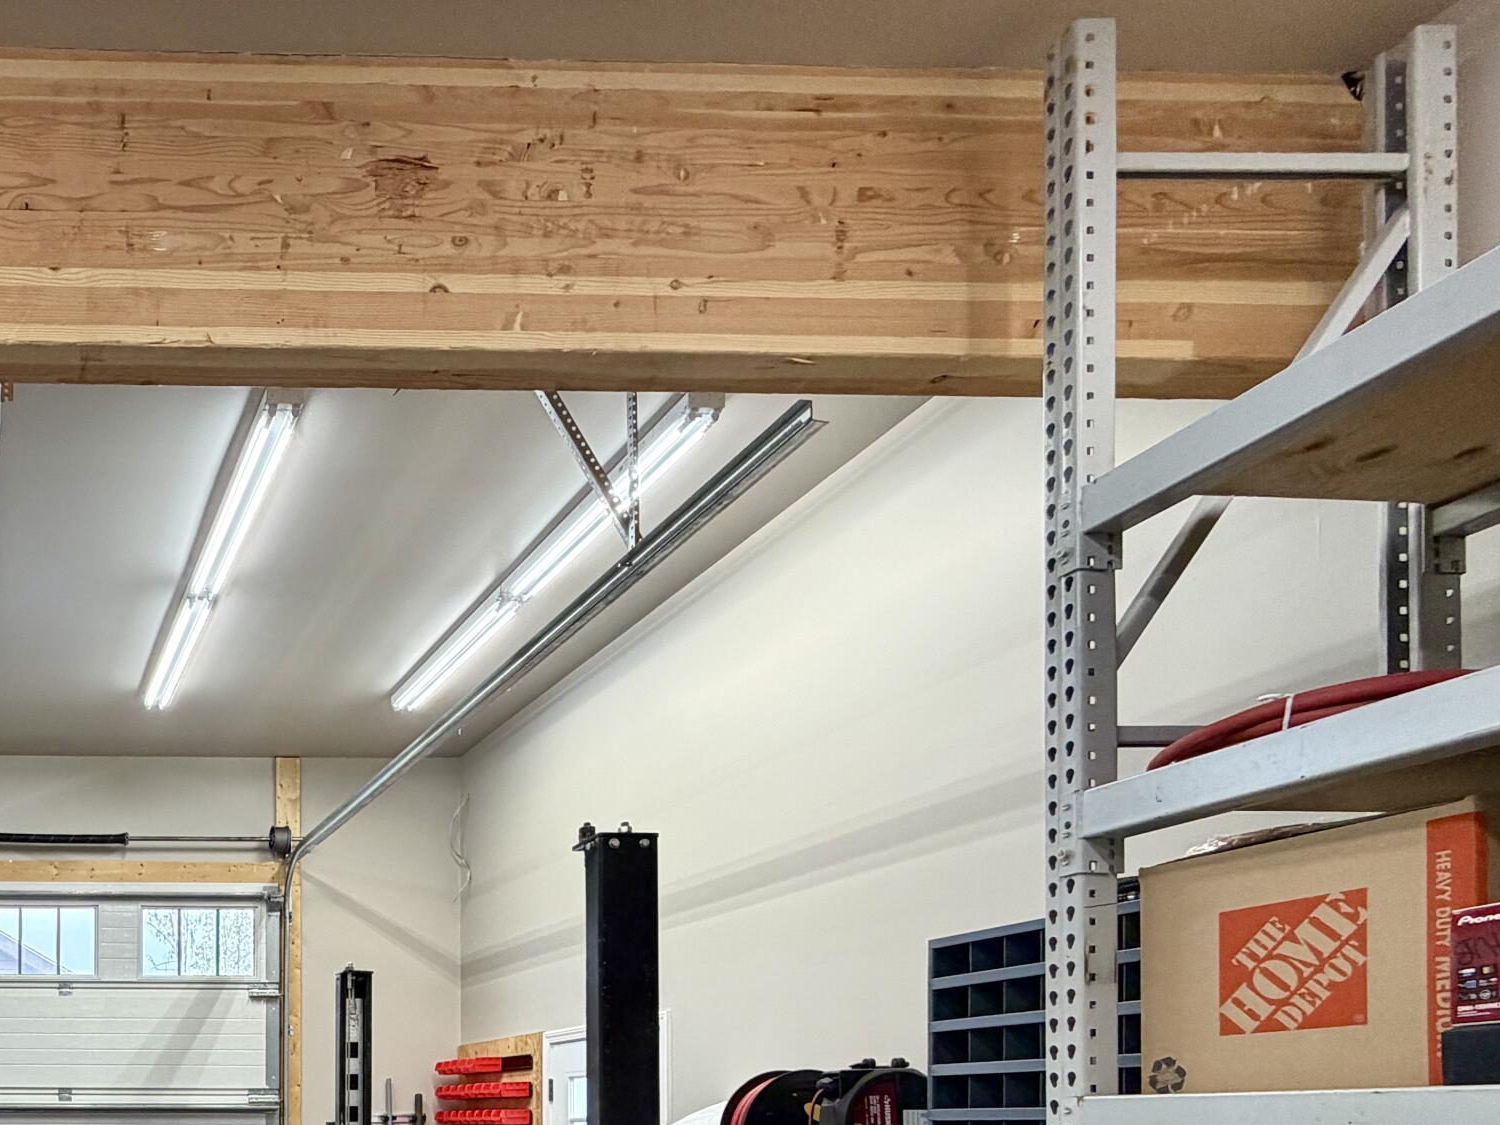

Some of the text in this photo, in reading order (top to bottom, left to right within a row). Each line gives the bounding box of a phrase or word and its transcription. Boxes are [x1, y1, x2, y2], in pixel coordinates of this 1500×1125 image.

[1435, 850, 1452, 901] HEAVY
[1231, 916, 1292, 972] THE
[1435, 907, 1452, 947] DUTY
[1220, 891, 1368, 1034] HOME
[1273, 940, 1367, 1031] DEPOT
